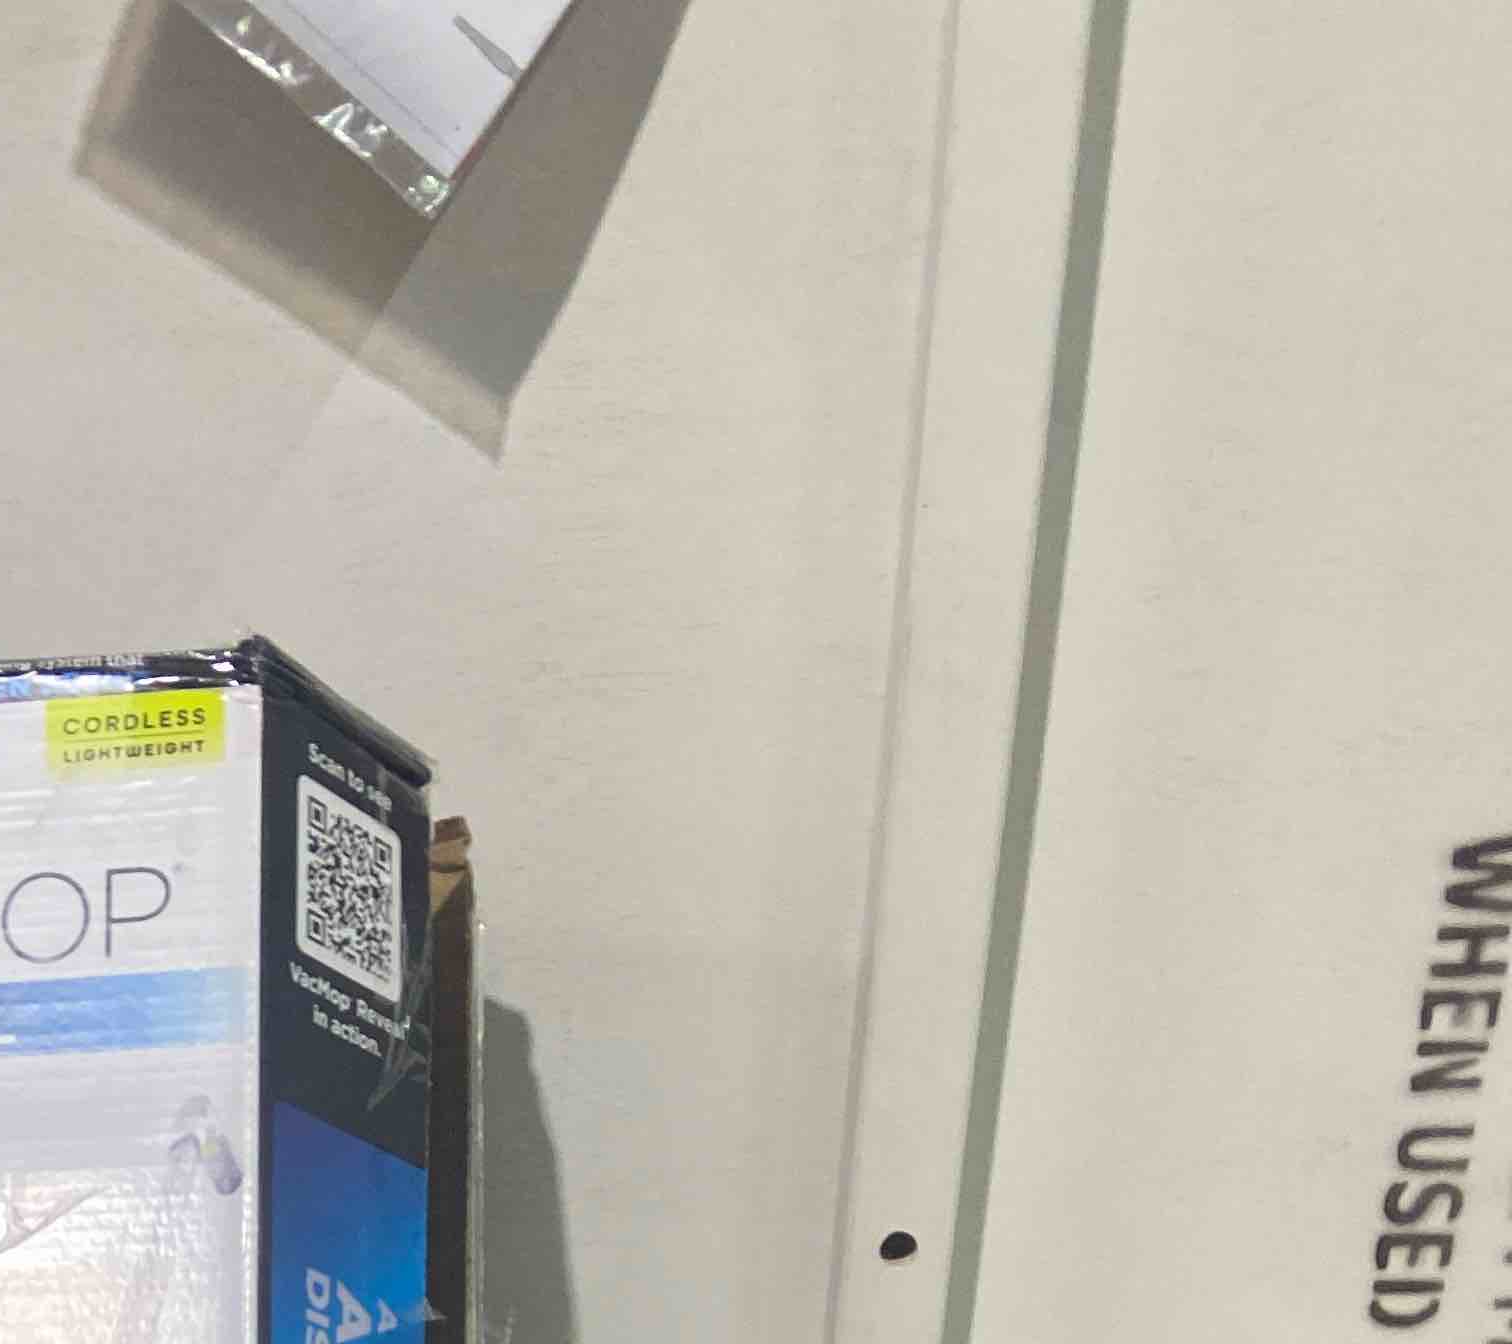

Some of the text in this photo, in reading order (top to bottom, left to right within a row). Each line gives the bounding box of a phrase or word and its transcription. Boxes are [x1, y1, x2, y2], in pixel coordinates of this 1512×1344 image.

[63, 707, 206, 735] CORDLESS
[63, 740, 205, 763] LIGHTWEIGHT
[1408, 832, 1512, 1093] WHEN
[1366, 1123, 1475, 1329] USED
[376, 1297, 399, 1334] A
